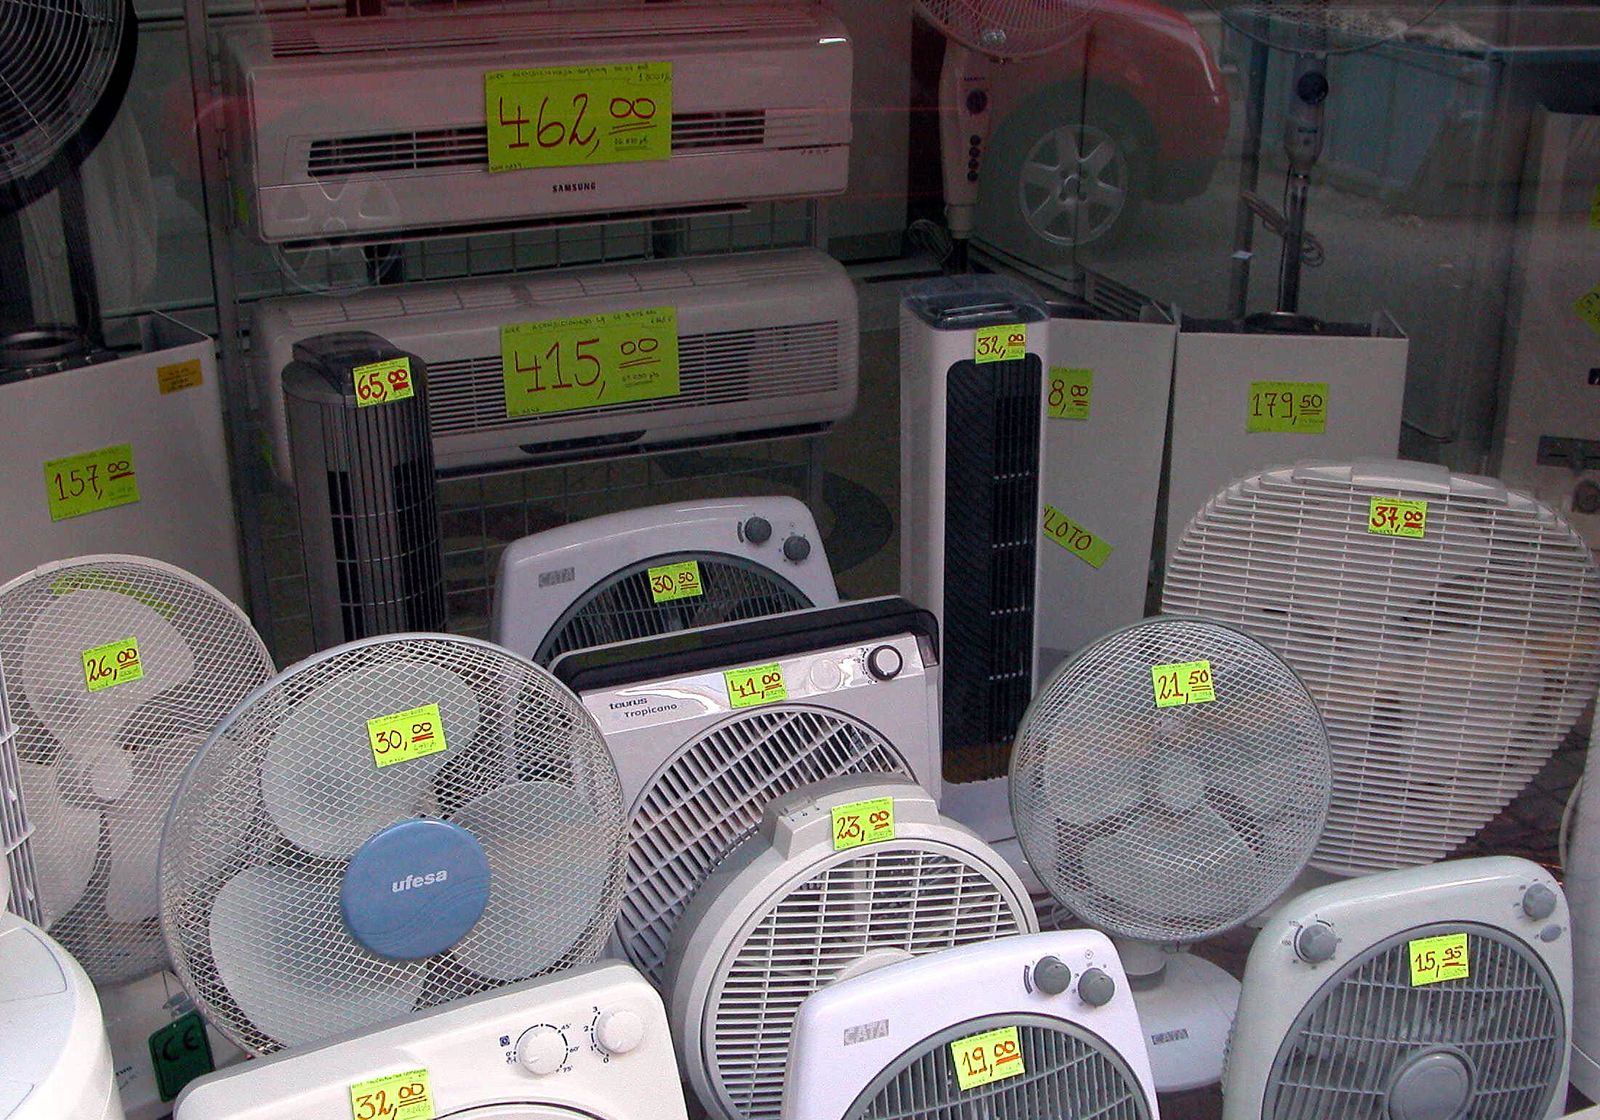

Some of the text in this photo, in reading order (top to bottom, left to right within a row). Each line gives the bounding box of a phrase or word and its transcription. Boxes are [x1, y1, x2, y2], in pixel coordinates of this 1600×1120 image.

[552, 182, 597, 193] SAMSUNG
[609, 697, 648, 711] taurus
[624, 703, 678, 719] Tropicano
[391, 870, 448, 893] ufesa
